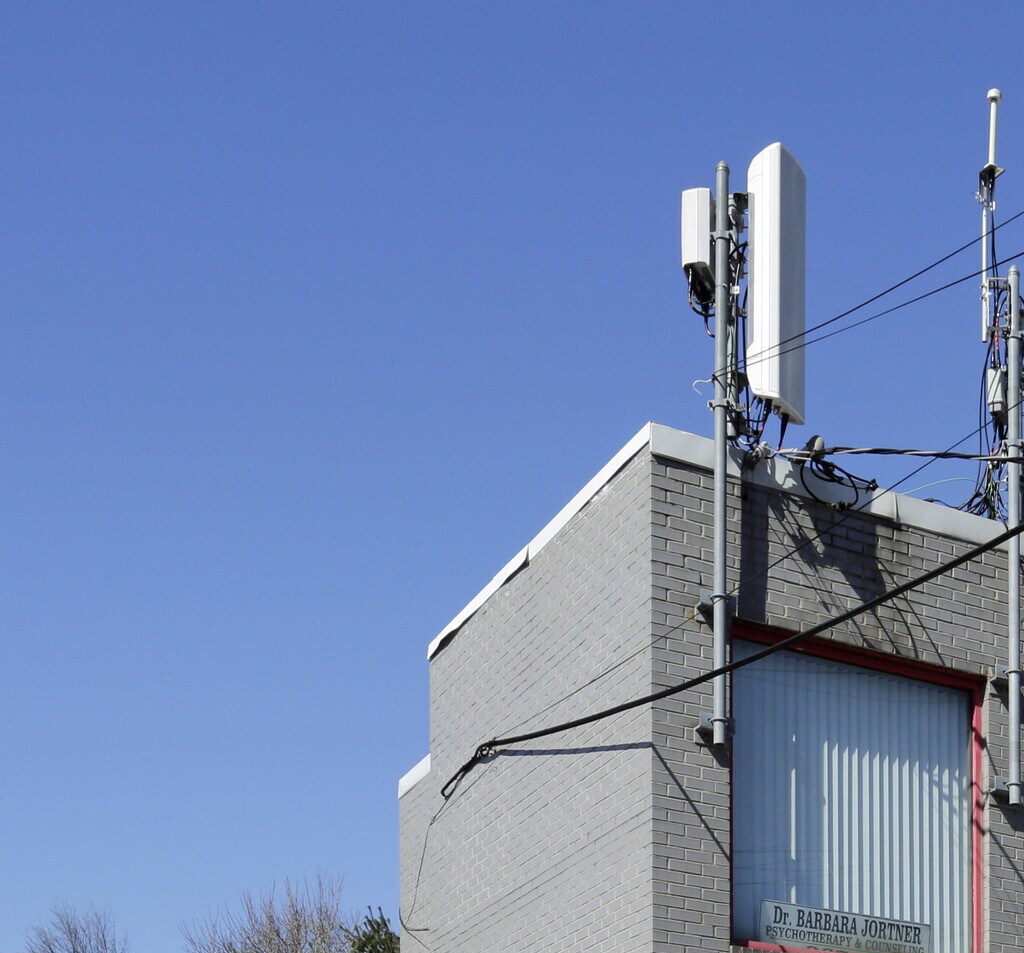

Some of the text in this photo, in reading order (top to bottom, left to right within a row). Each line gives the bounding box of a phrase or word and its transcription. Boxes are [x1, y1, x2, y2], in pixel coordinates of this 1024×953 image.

[766, 925, 852, 948] PSYCHOTHERAPY
[855, 938, 862, 949] &
[773, 905, 922, 945] Dr. BARBARA JORTNER
